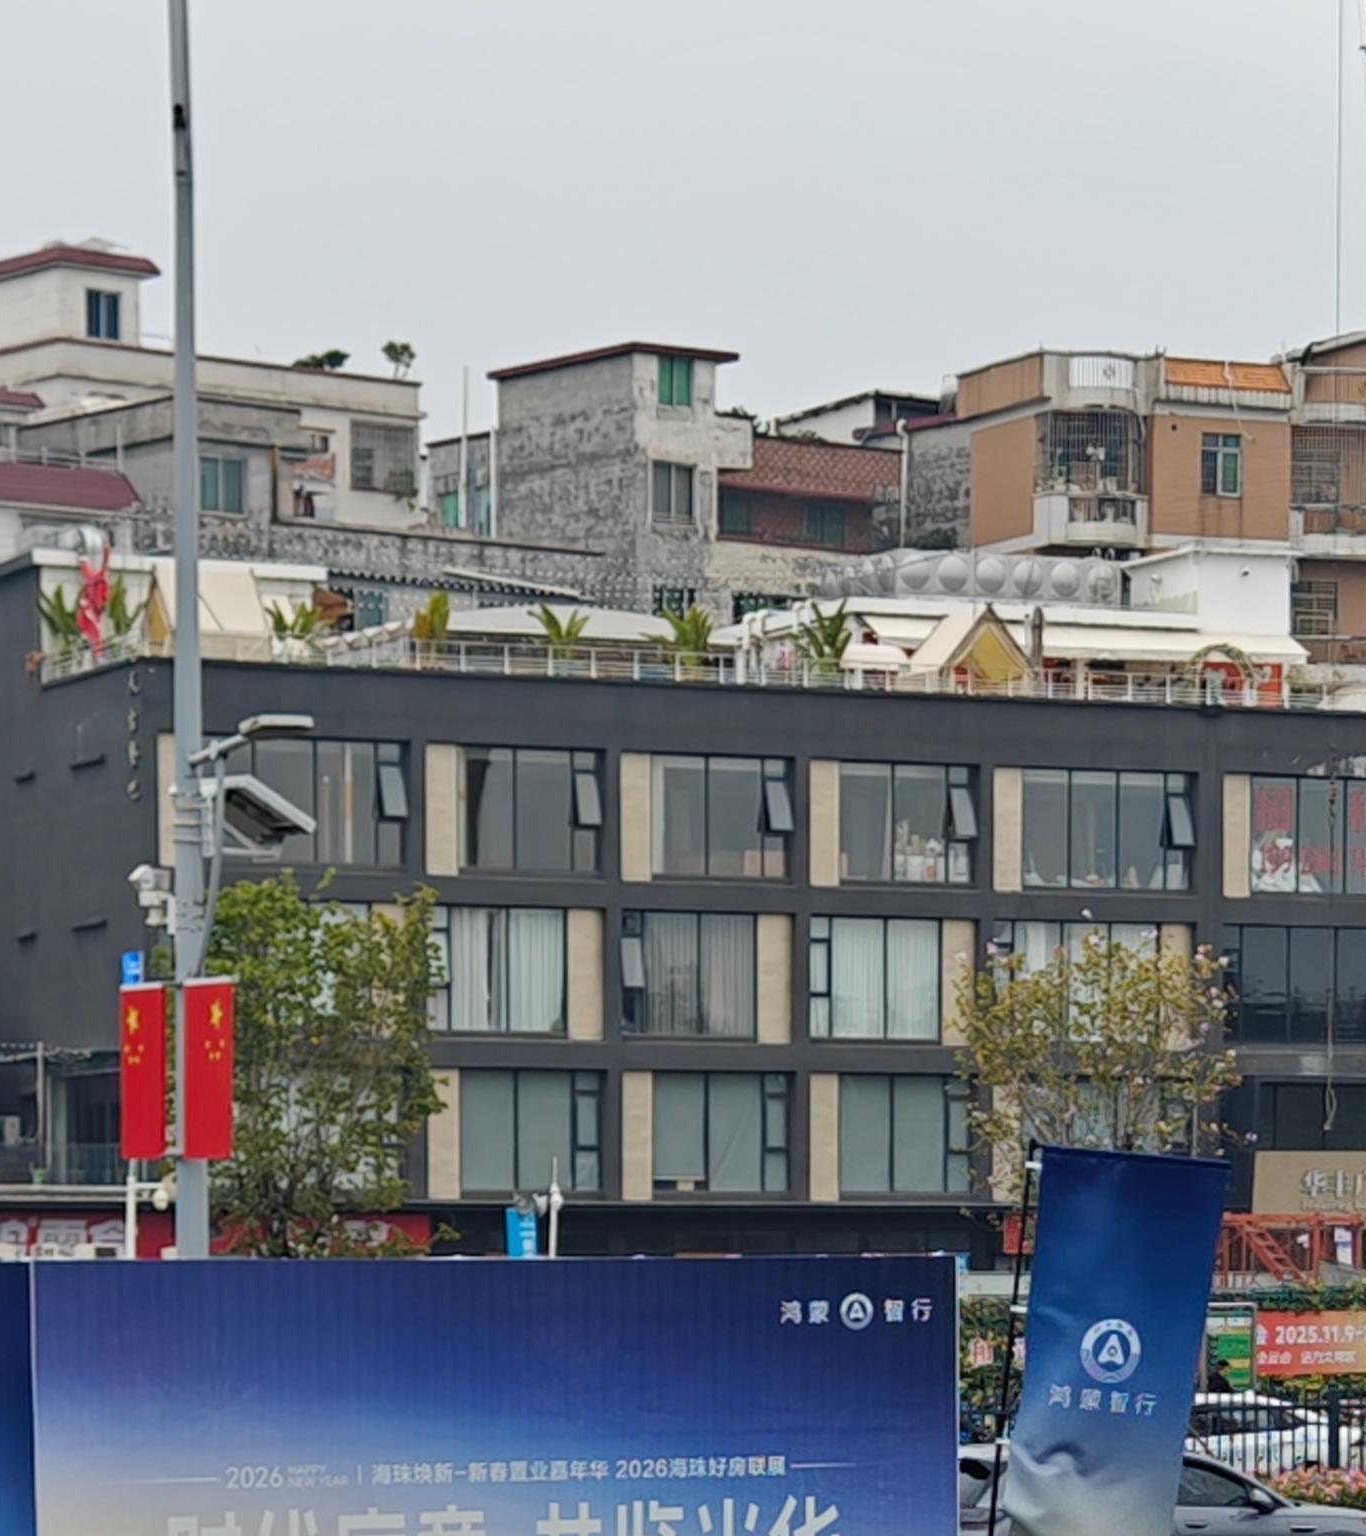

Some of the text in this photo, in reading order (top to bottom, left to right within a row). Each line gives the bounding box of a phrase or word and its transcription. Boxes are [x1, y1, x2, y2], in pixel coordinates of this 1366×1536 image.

[780, 1299, 933, 1324] 鸿蒙 智行
[1047, 1383, 1156, 1416] 鸿蒙智行
[225, 1466, 284, 1489] 2026
